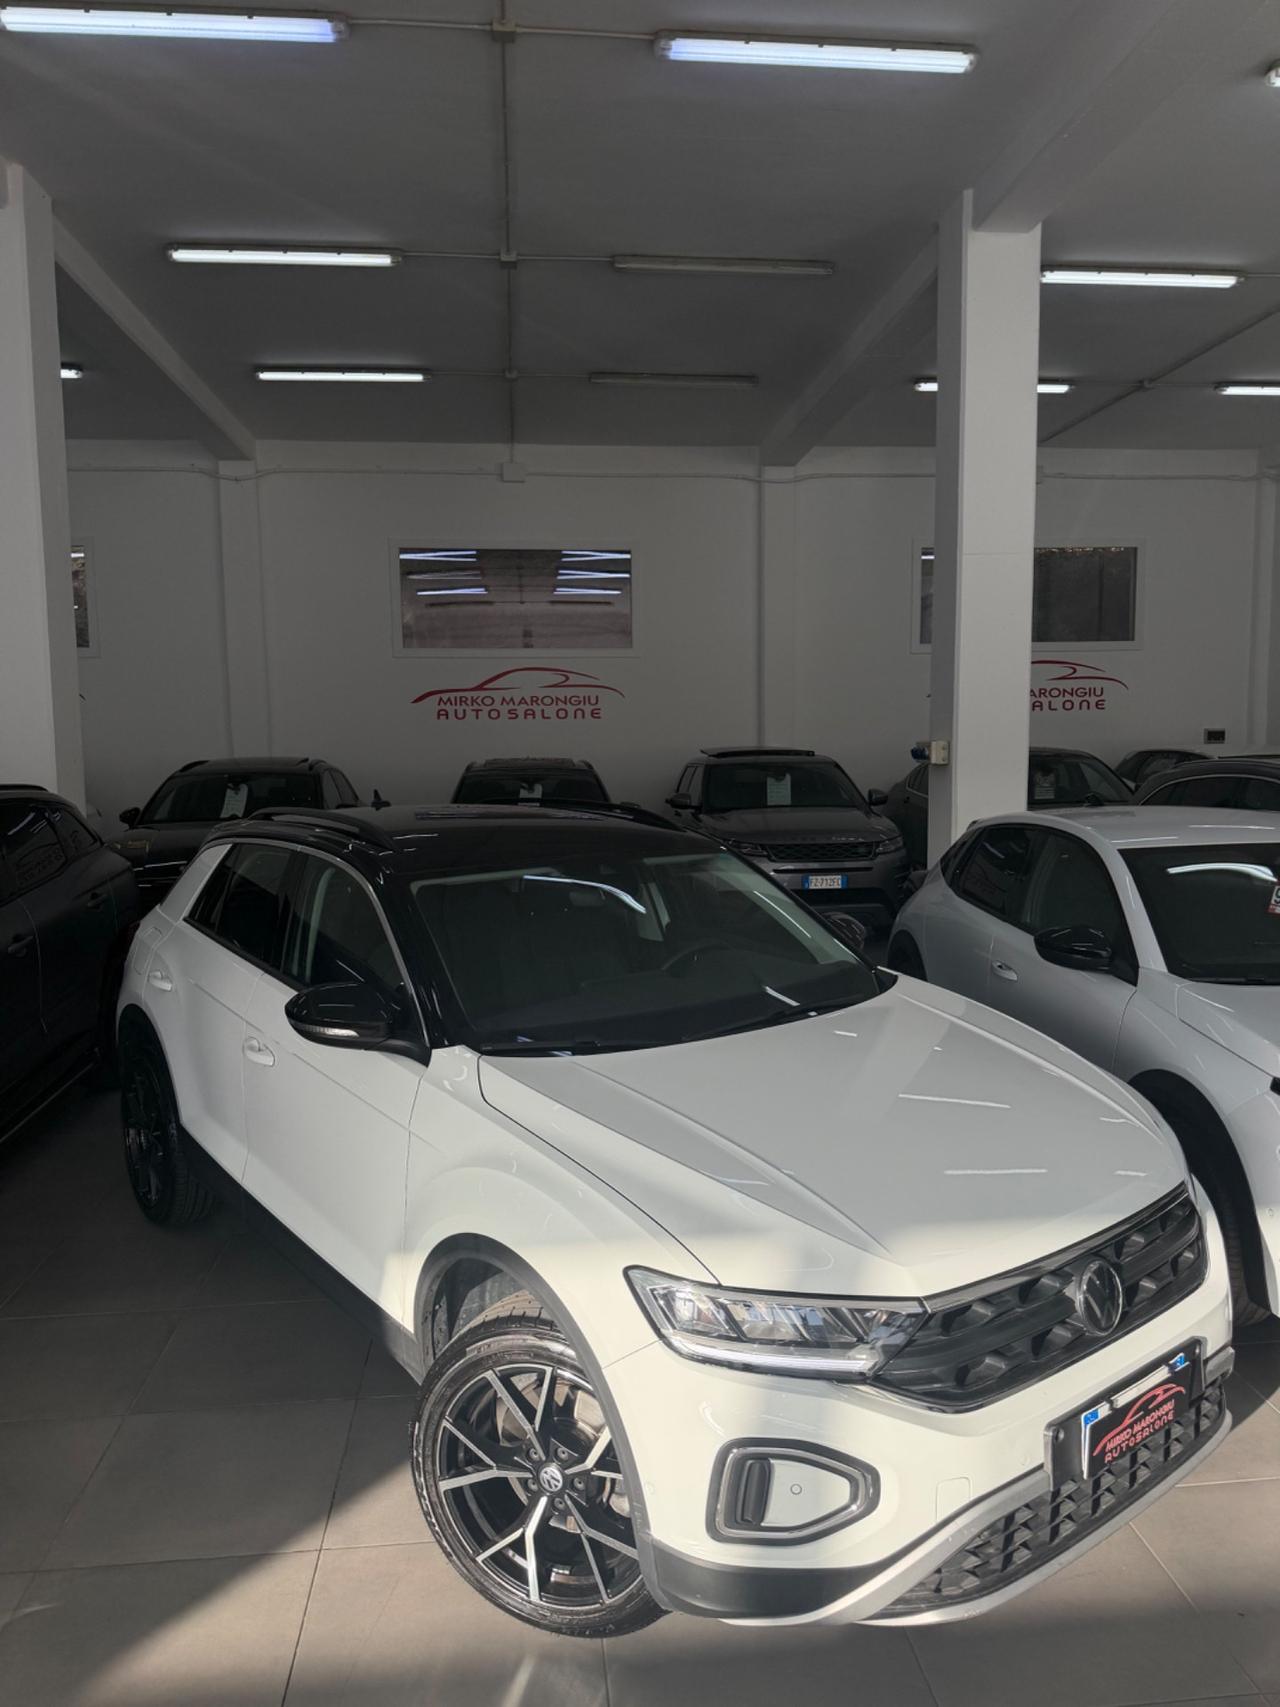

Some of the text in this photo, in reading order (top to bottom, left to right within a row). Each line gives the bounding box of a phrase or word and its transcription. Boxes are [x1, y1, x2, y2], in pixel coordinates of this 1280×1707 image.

[437, 694, 600, 707] MIRKO MARONGIU
[437, 708, 602, 720] AUTOSALONE
[1103, 1410, 1175, 1463] AUTOSALONE
